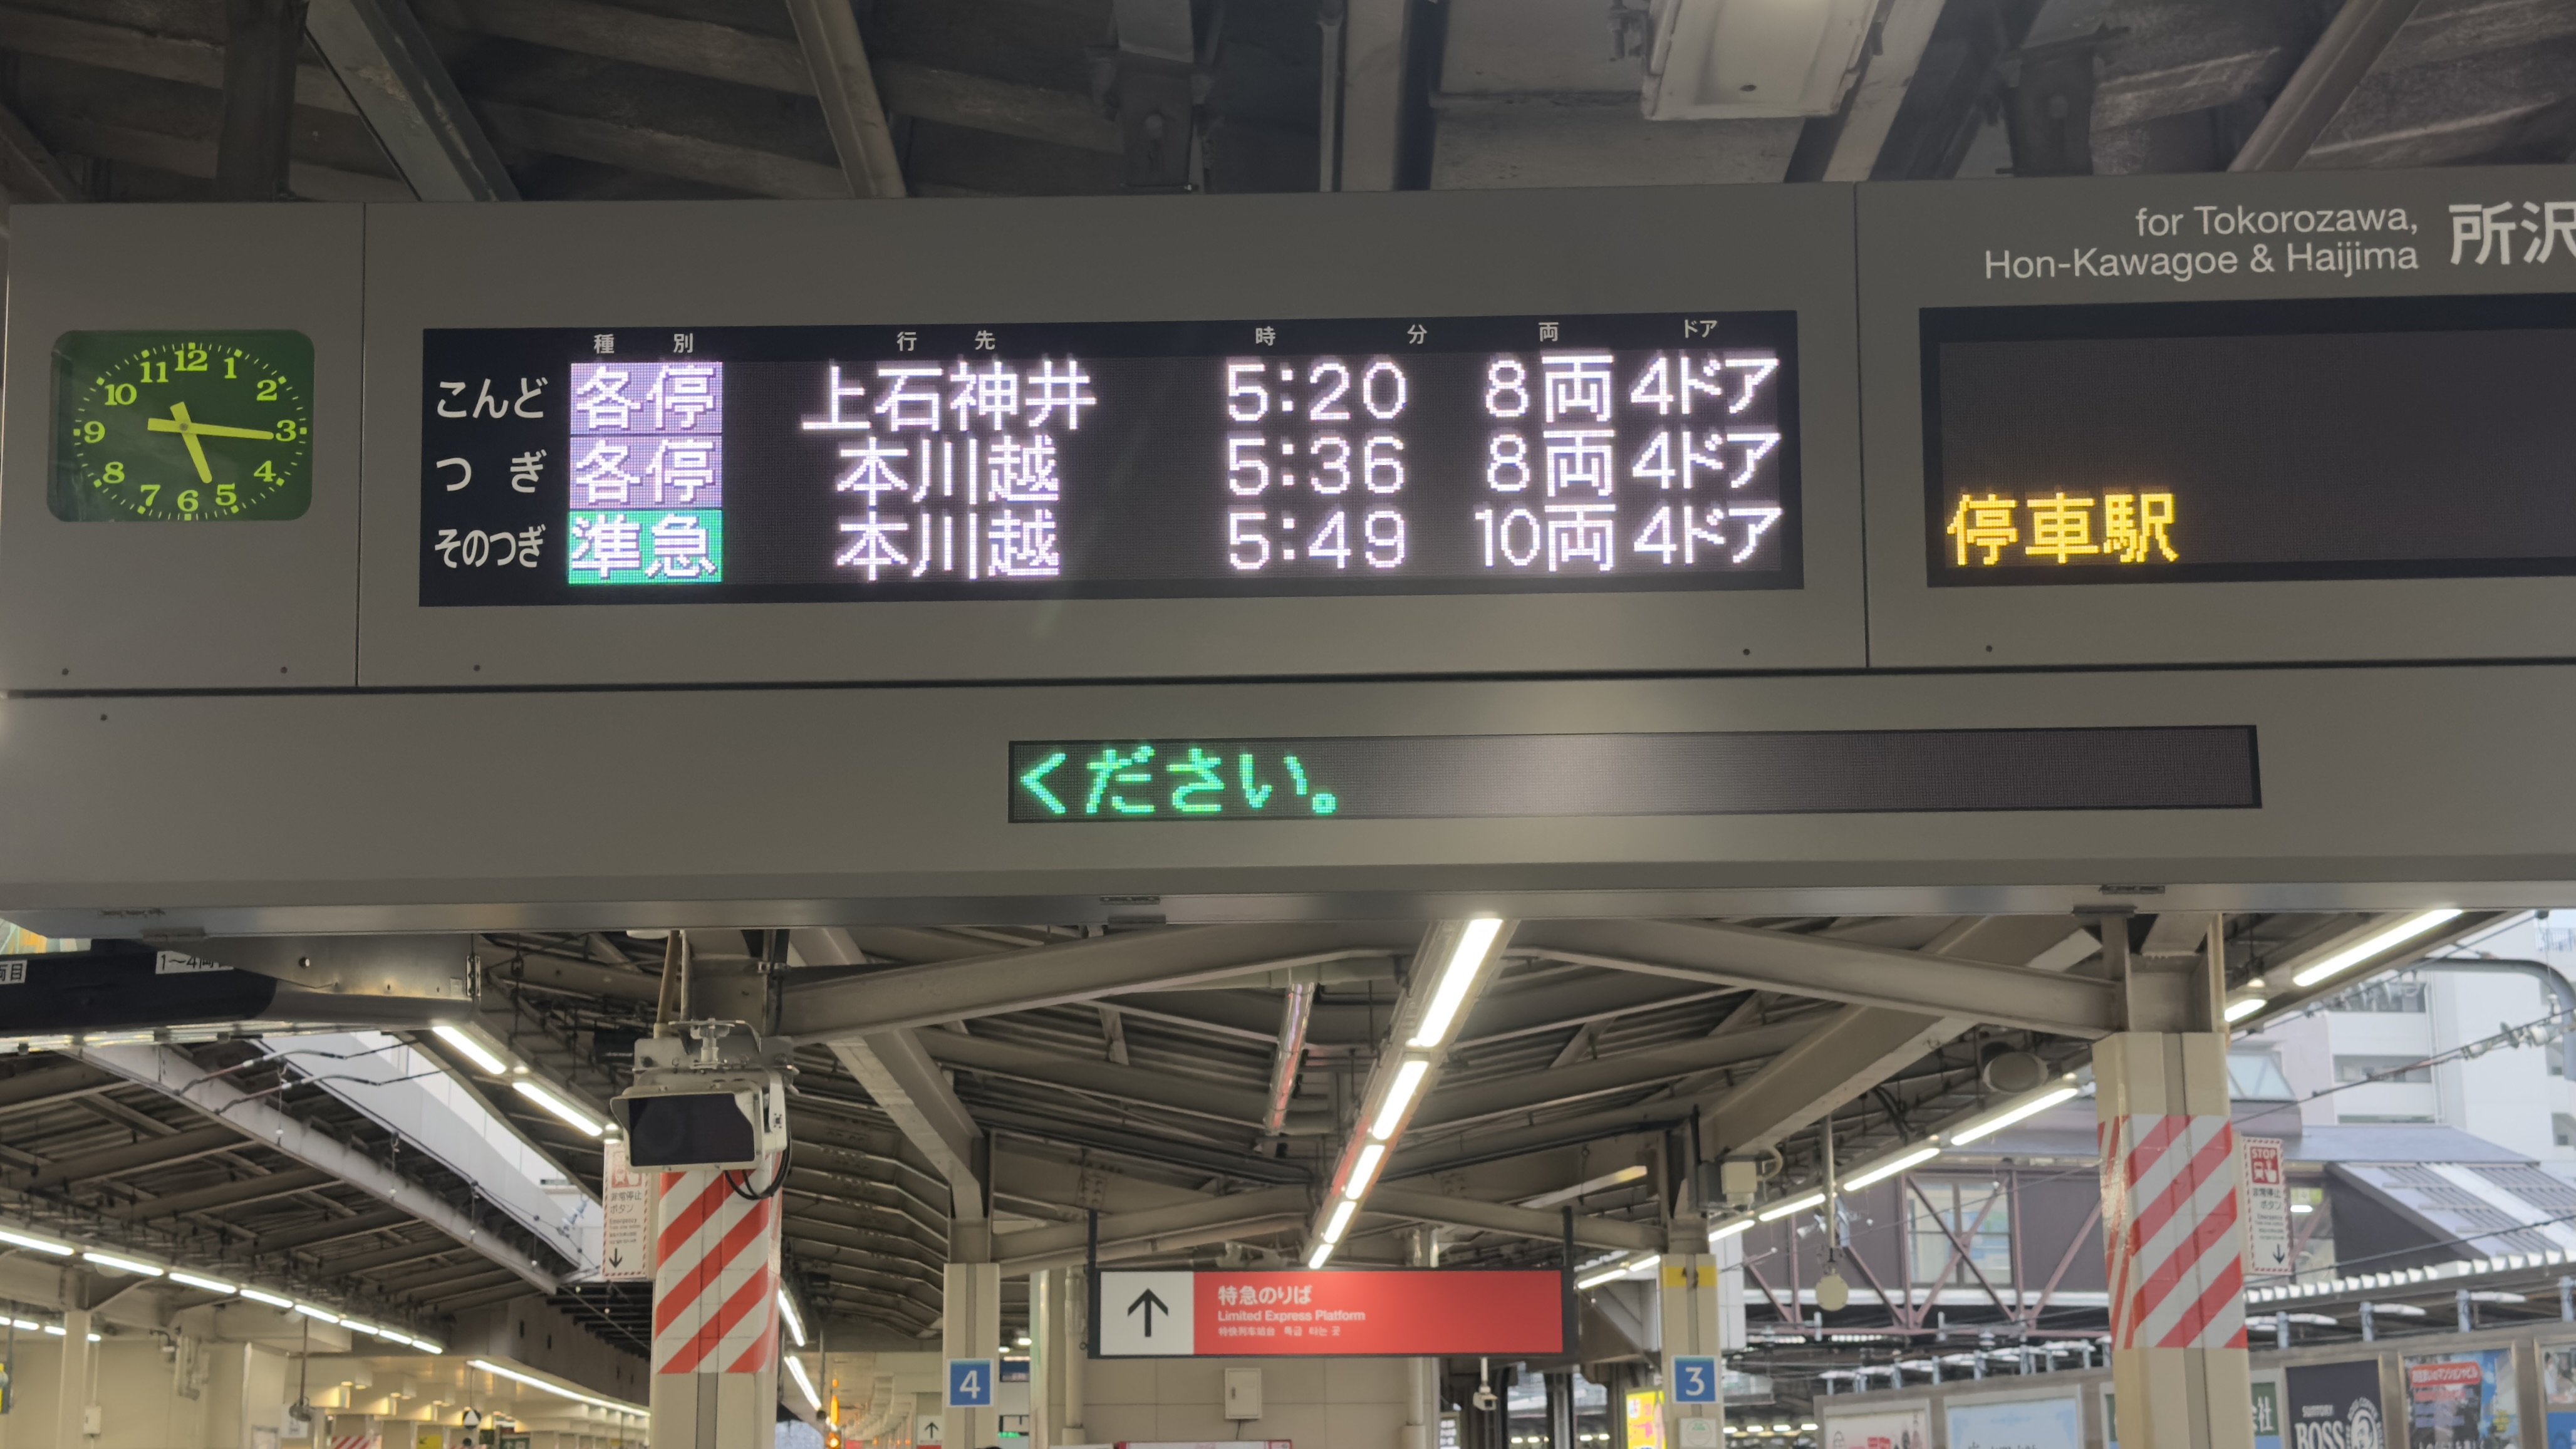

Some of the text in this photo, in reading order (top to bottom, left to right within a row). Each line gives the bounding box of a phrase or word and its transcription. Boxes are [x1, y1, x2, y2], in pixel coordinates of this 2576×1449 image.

[2136, 205, 2417, 236] for Tokorozawa,
[2449, 202, 2576, 264] 所沢
[1986, 242, 2418, 282] Hon-Kawagoe & Haijima
[1539, 323, 1558, 341] 両
[1684, 319, 1717, 338] ドア
[141, 362, 168, 382] 11
[174, 348, 207, 371] 12
[225, 356, 238, 378] 1
[103, 382, 137, 405] 10
[257, 379, 279, 400] 2
[437, 378, 548, 418] こんど
[575, 365, 715, 431] 各停
[802, 360, 1096, 431] 上石神井
[1228, 362, 1406, 421] 5:20
[1486, 355, 1613, 422] 8両
[1631, 356, 1778, 415] 4ドア
[85, 421, 105, 443] 9
[276, 420, 296, 441] 3
[103, 462, 125, 483] 8
[254, 460, 277, 482] 4
[574, 439, 715, 504] 各停
[837, 435, 1058, 506] 本川越
[1229, 436, 1404, 495] 5:36
[1487, 430, 1614, 497] 8両
[1633, 431, 1780, 489] 4ドア
[139, 485, 160, 508] 7
[178, 490, 198, 511] 6
[216, 484, 237, 507] 5
[1230, 511, 1405, 569] 5:49
[1475, 504, 1616, 571] 10両
[1634, 506, 1781, 564] 4ドア
[1947, 492, 2178, 565] 停車駅
[435, 524, 546, 568] そのつぎ
[571, 514, 715, 579] 準急
[837, 509, 1059, 581] 本川越
[1021, 746, 1336, 814] ください。
[2251, 1148, 2276, 1159] STOP
[610, 1203, 634, 1214] ボタン
[2261, 1200, 2282, 1210] ボタン
[1218, 1285, 1312, 1306] 特急のりば
[1218, 1310, 1366, 1323] Limited Express Platform
[960, 1371, 980, 1398] 4
[1686, 1368, 1704, 1395] 3
[2302, 1405, 2334, 1418] SUNTORY
[2295, 1421, 2344, 1449] BOSS
